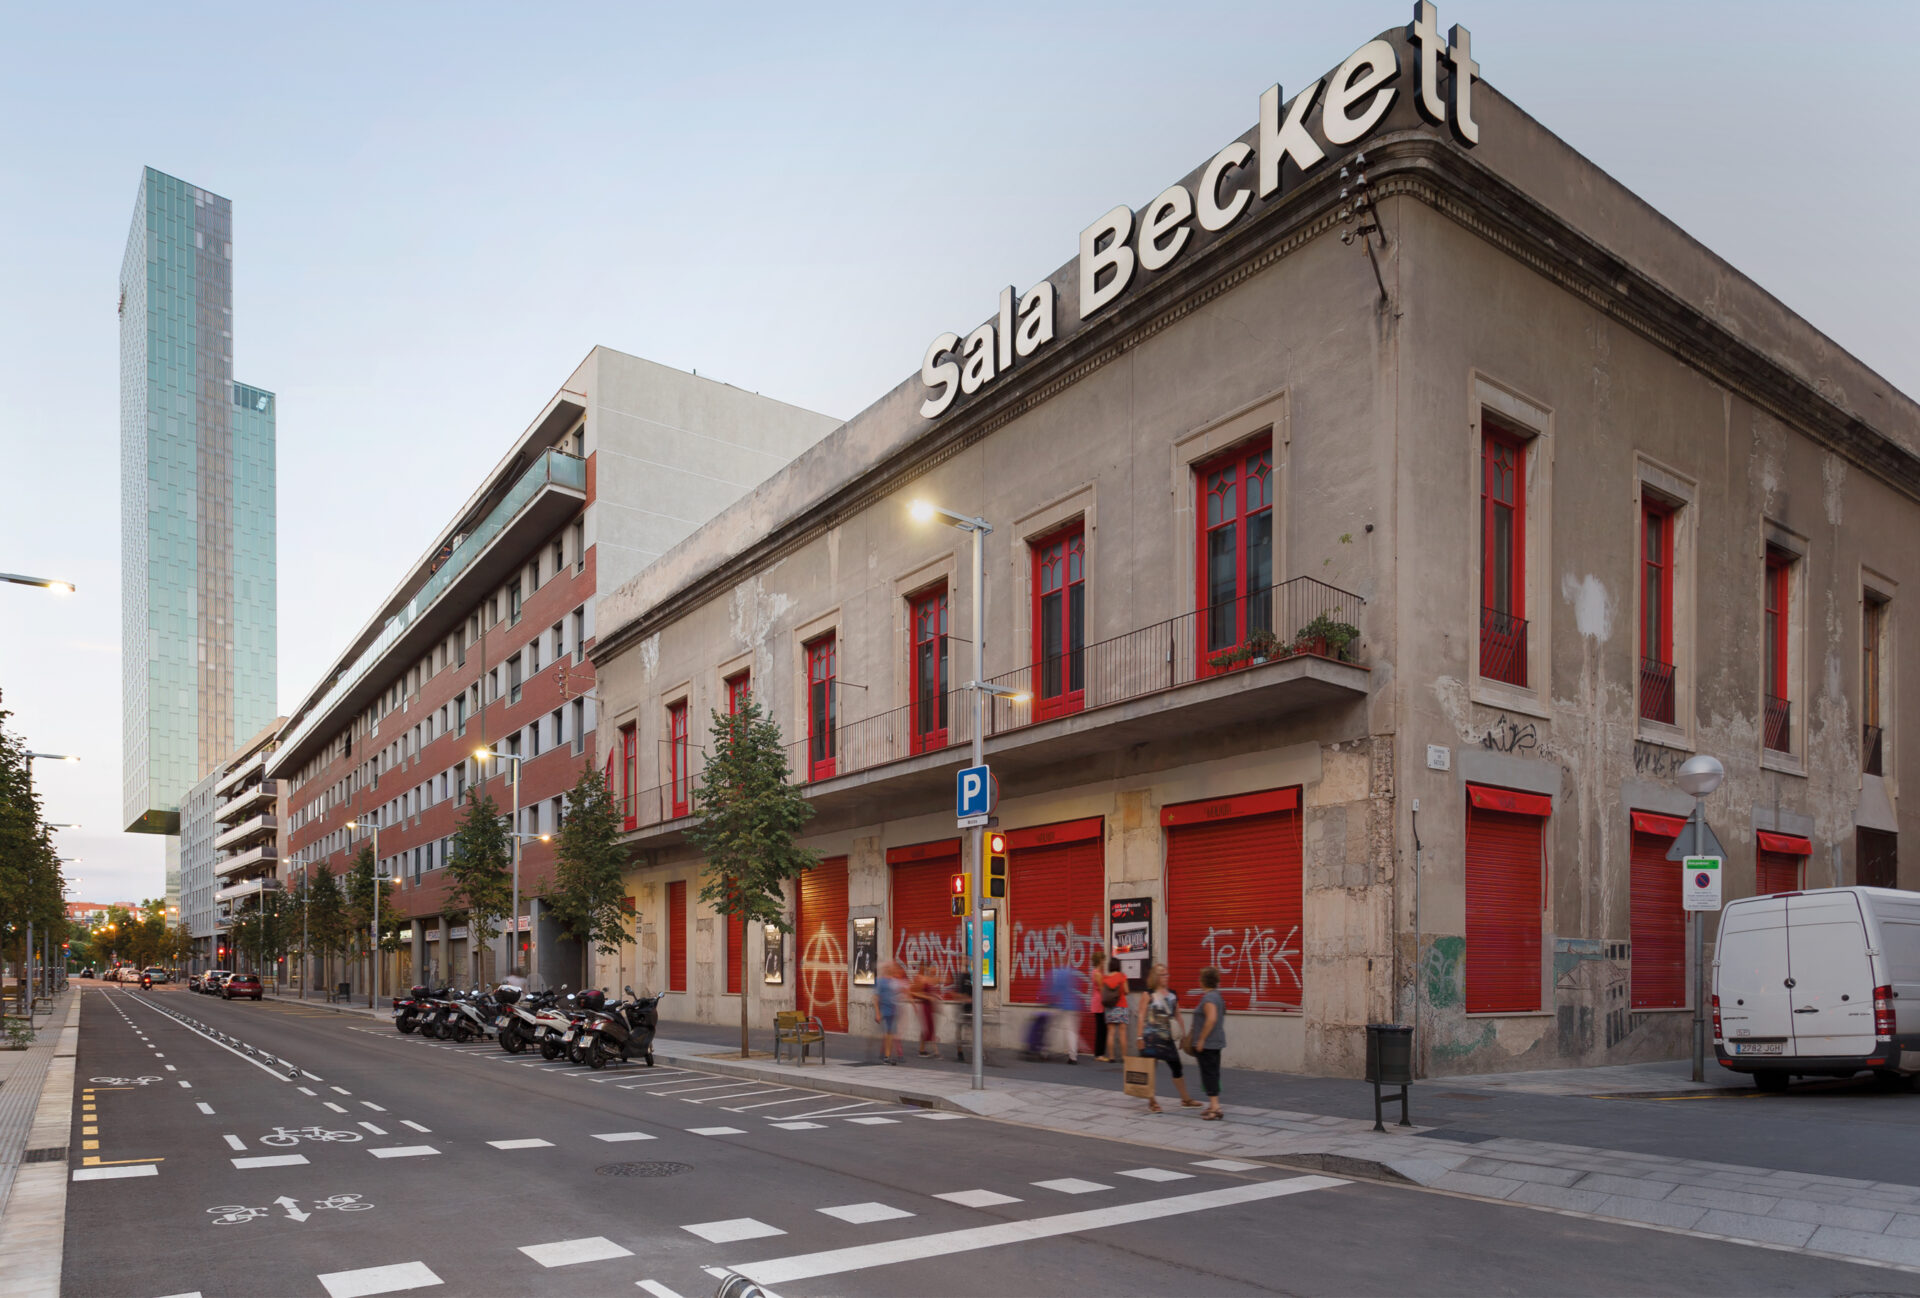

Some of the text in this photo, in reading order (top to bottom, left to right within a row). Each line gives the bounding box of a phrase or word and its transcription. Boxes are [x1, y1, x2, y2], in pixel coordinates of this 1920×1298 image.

[920, 0, 1480, 420] Sala Beckett
[963, 773, 982, 811] P
